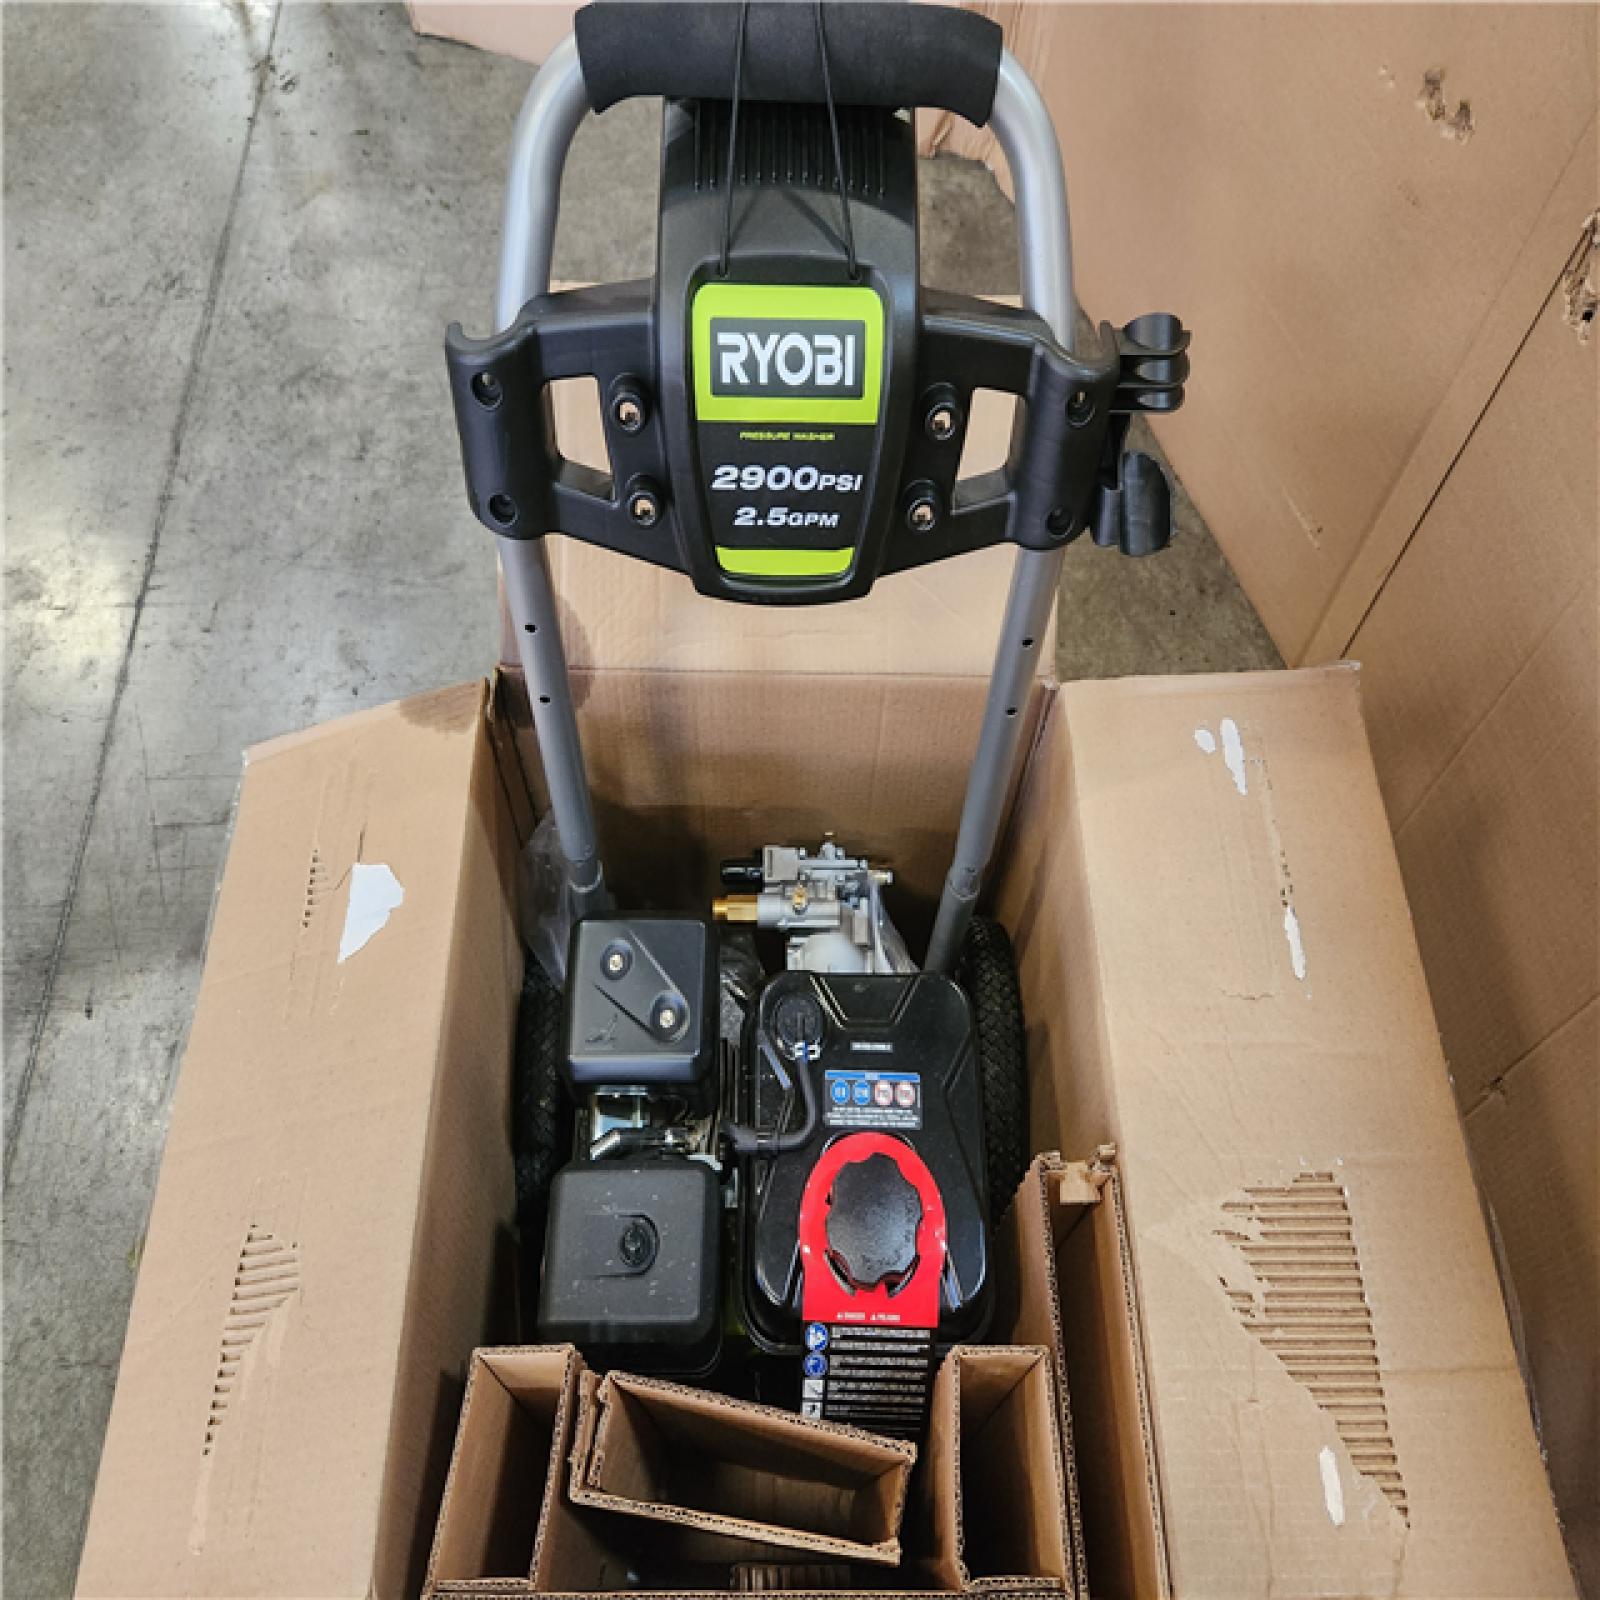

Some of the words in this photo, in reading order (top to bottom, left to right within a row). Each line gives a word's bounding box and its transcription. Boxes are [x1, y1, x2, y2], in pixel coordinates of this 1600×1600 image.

[716, 331, 856, 386] RYOBI
[711, 464, 863, 492] 2900PSI
[733, 506, 840, 528] 2.5GPM
